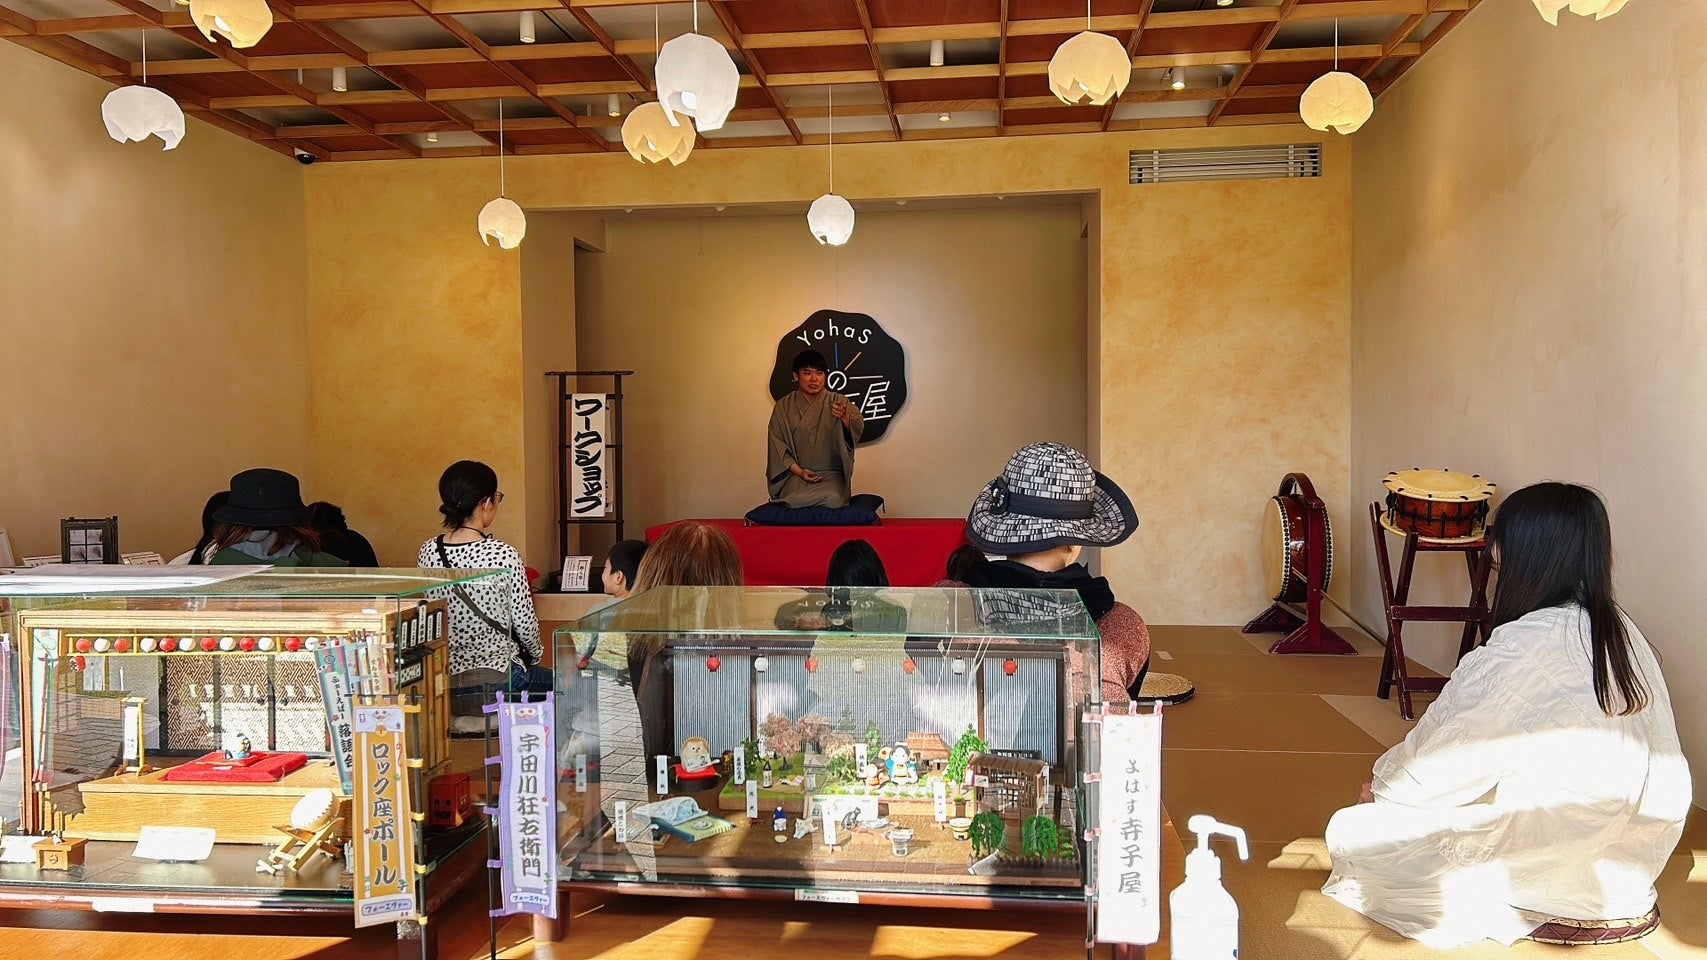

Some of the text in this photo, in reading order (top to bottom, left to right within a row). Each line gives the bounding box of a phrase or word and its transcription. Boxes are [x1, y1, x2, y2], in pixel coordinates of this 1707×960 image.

[827, 370, 847, 390] の
[574, 398, 602, 514] ワークショップ
[372, 743, 397, 887] ロック座ポール
[517, 733, 542, 877] 宇田川狂右衛門
[1118, 759, 1143, 894] よはす寺子屋
